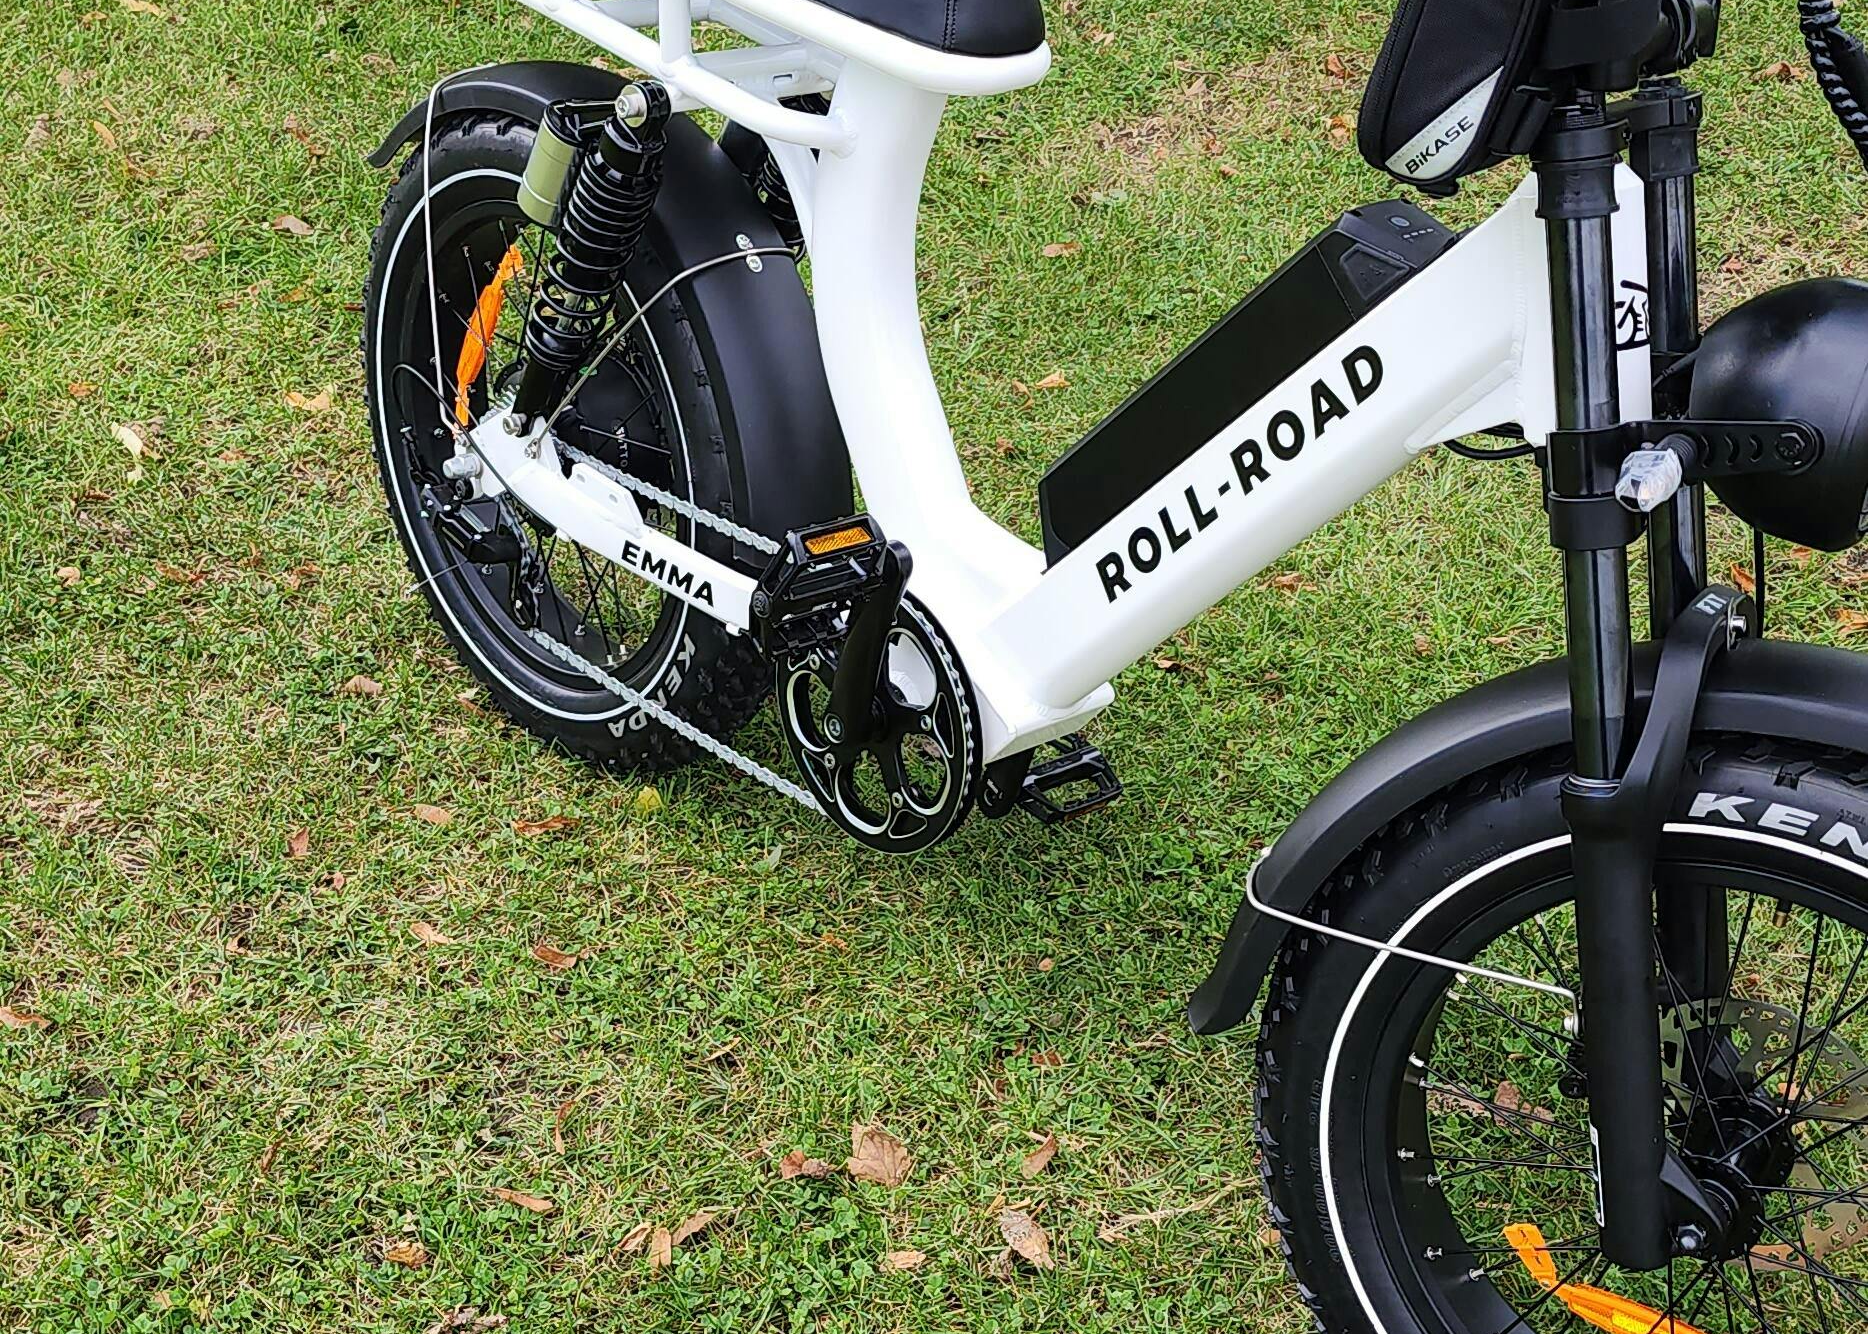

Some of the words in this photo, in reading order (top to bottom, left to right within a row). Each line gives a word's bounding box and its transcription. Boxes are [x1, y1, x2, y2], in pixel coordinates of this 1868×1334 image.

[1404, 115, 1475, 175] BiKASE
[1095, 344, 1385, 604] ROLL-ROAD
[620, 539, 715, 608] EMMA
